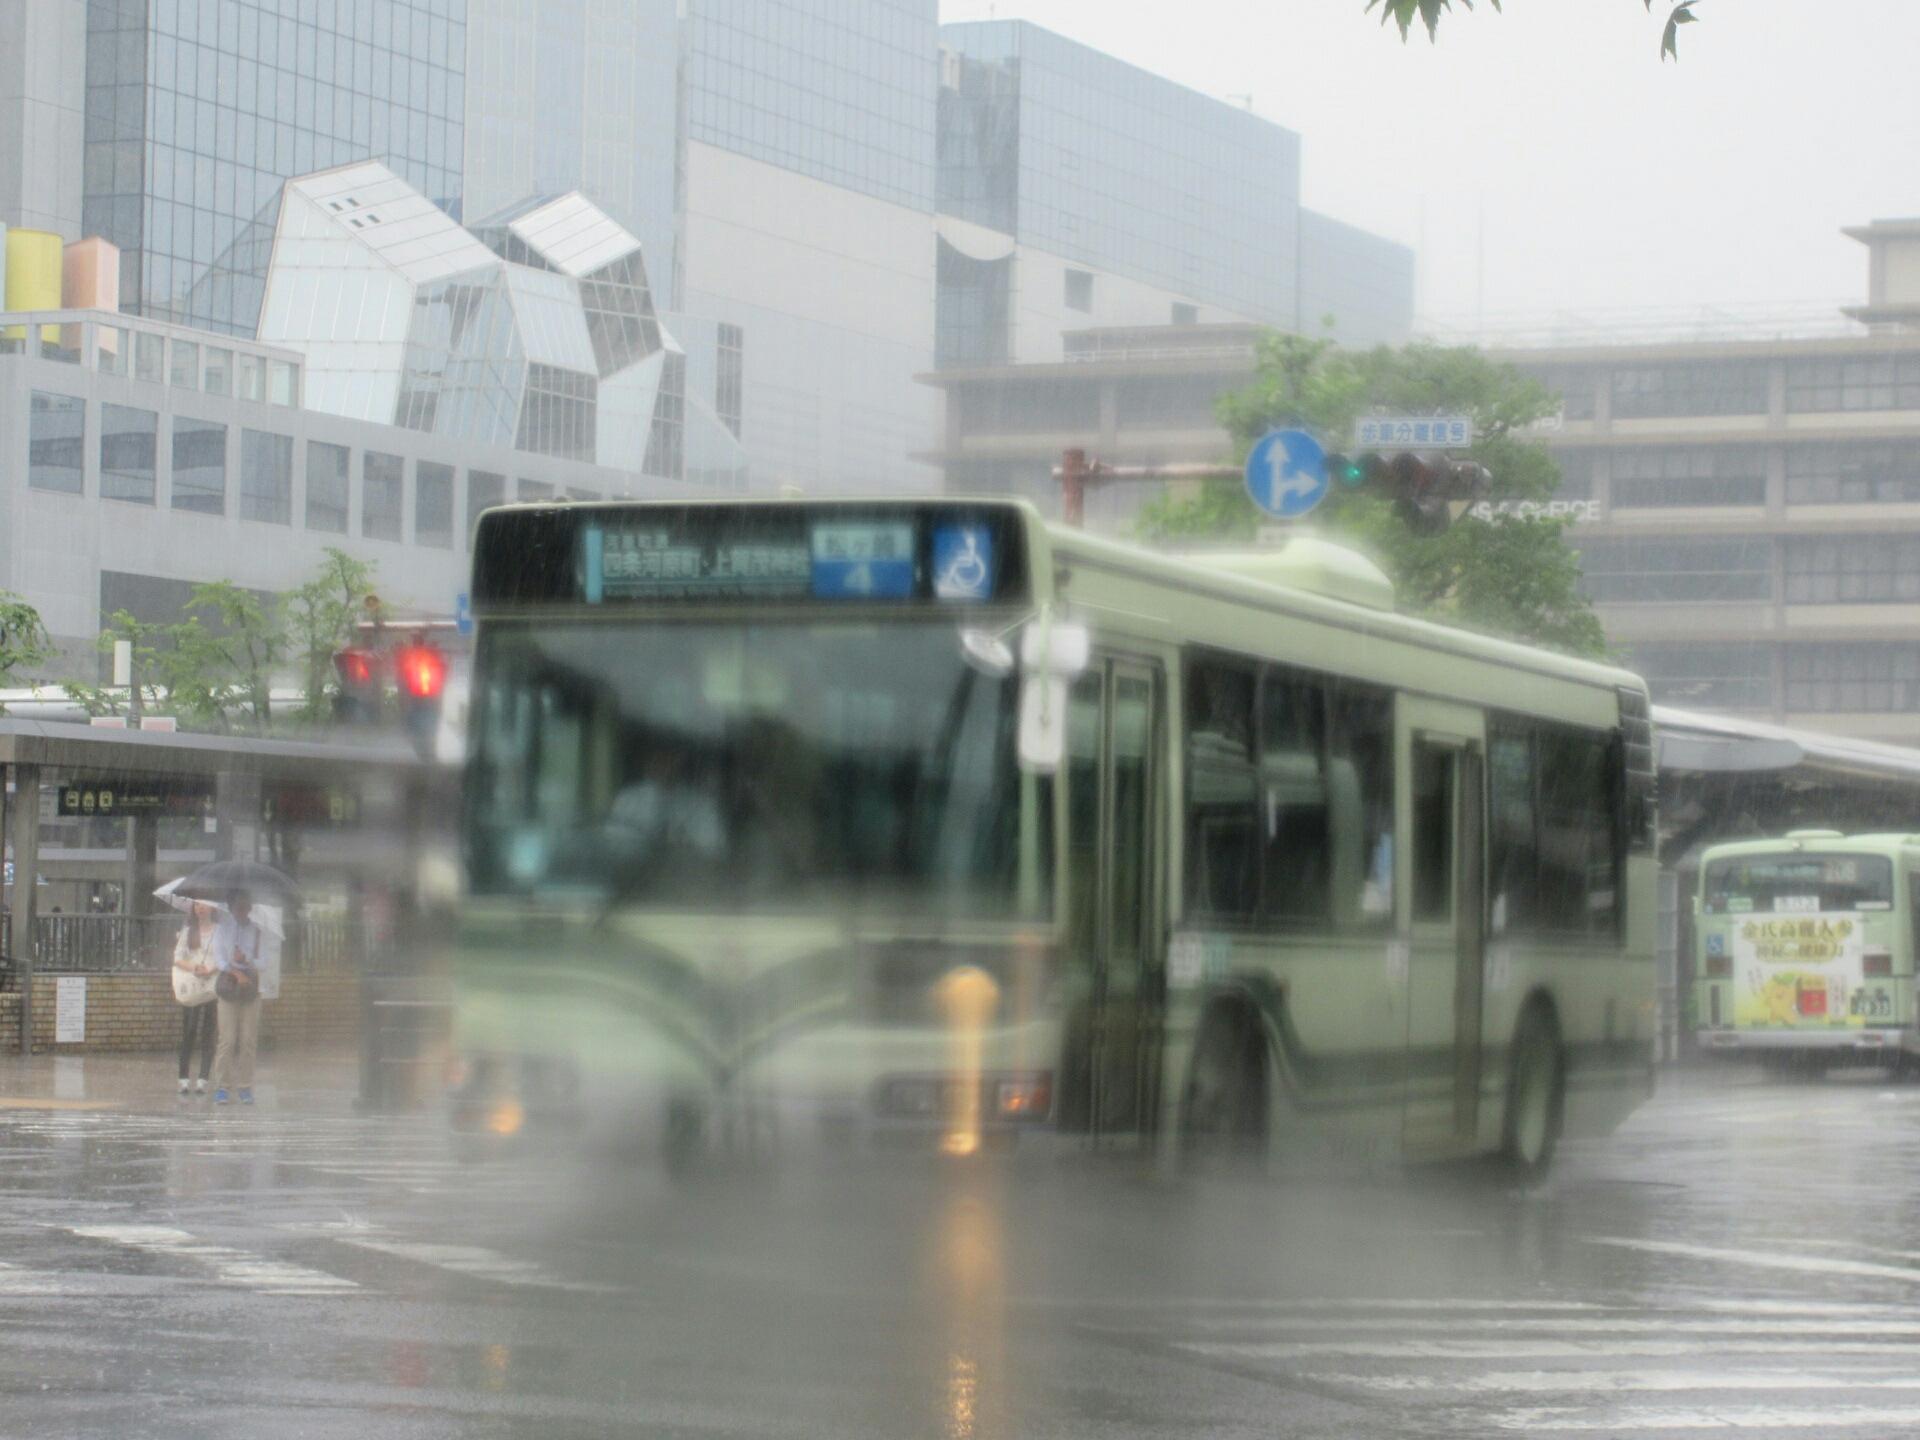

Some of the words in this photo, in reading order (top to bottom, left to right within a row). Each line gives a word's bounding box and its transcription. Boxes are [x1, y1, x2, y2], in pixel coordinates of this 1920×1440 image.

[1361, 422, 1467, 442] 歩車分離信号
[843, 561, 872, 595] 4
